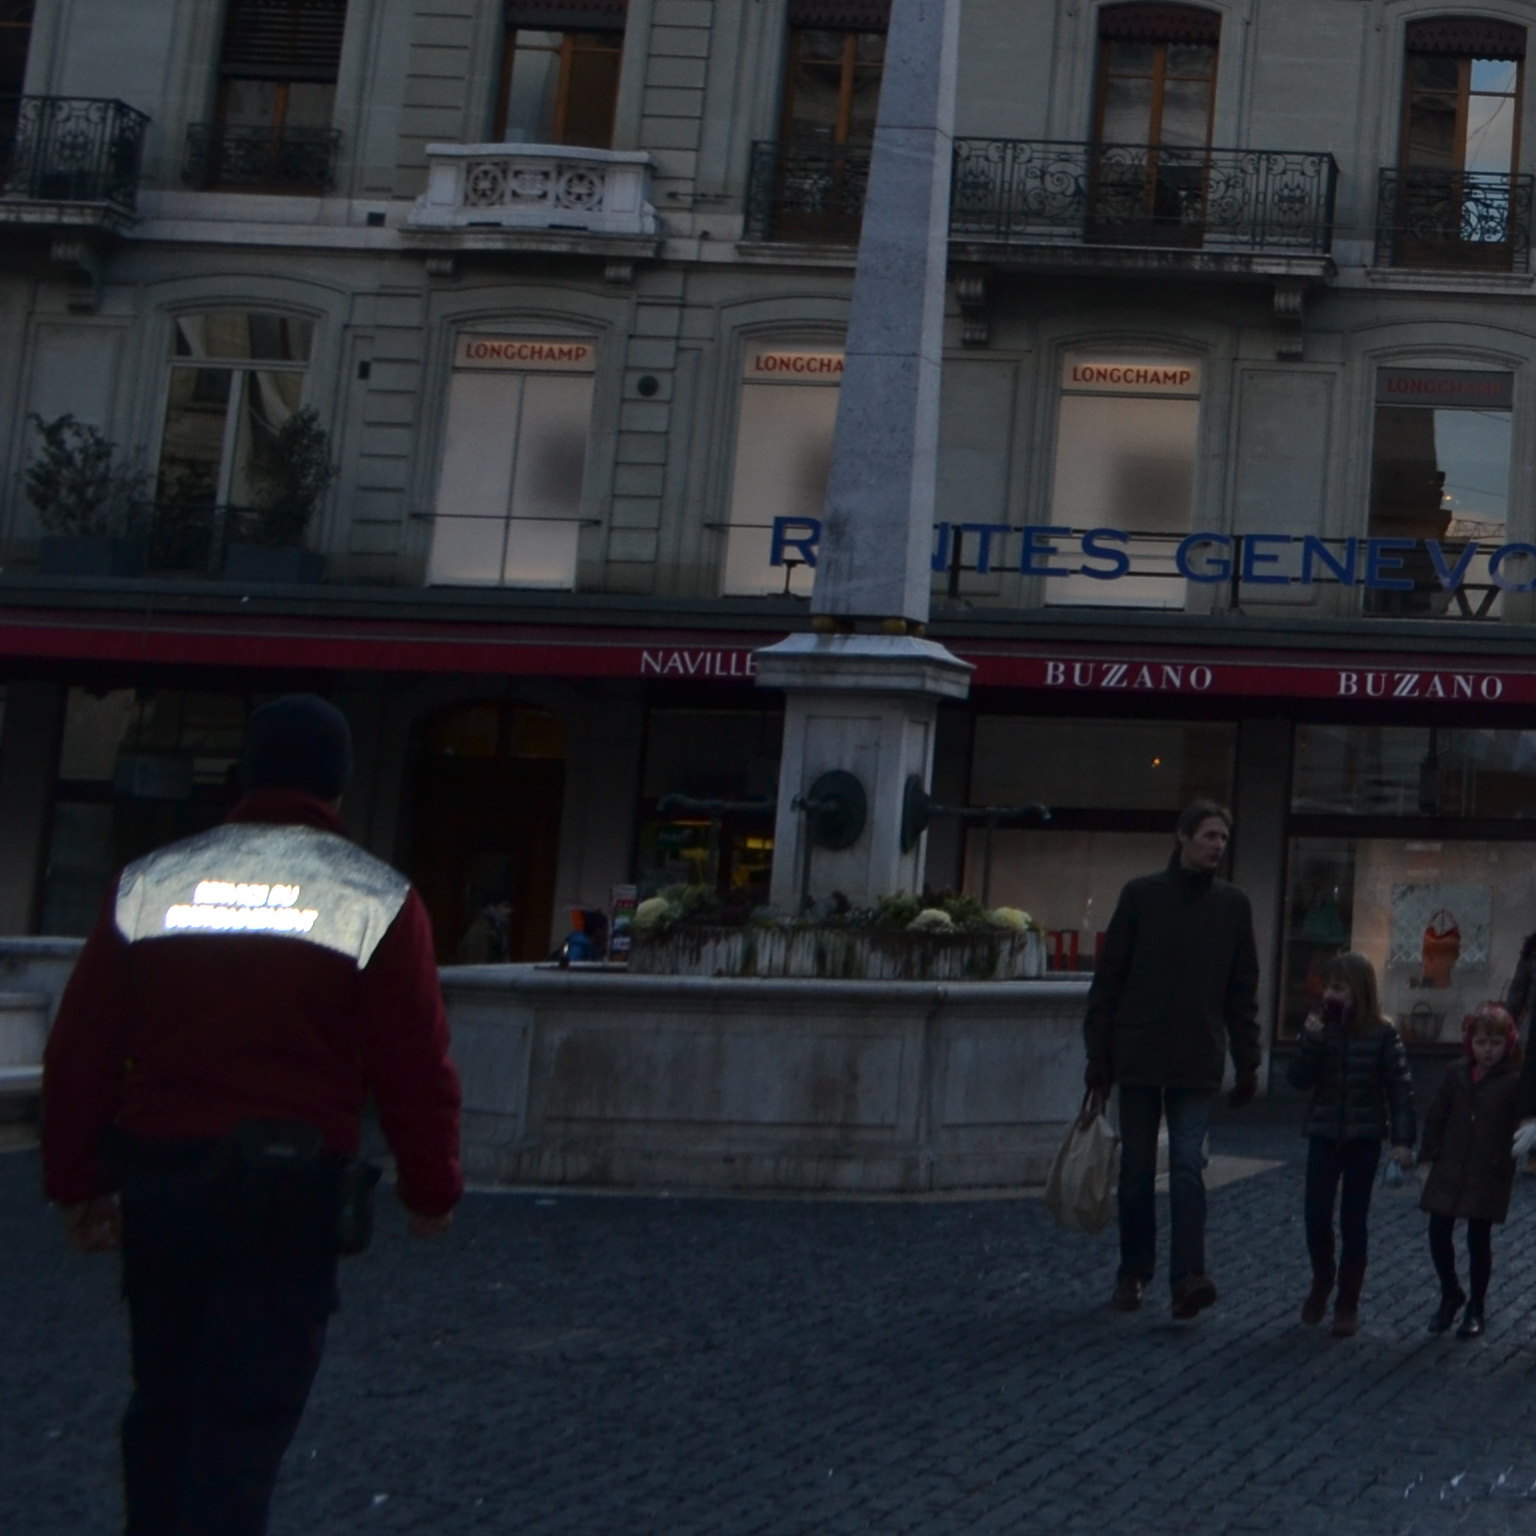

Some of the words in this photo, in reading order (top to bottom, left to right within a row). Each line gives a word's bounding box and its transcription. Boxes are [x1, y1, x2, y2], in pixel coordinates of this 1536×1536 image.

[466, 343, 587, 361] LONGCHAMP
[755, 355, 844, 373] LONGCHA
[1072, 367, 1190, 385] LONGCHAMP
[640, 650, 757, 676] NAVILLE
[1043, 660, 1213, 690] BUZZANO
[1338, 671, 1504, 700] BUZZANO
